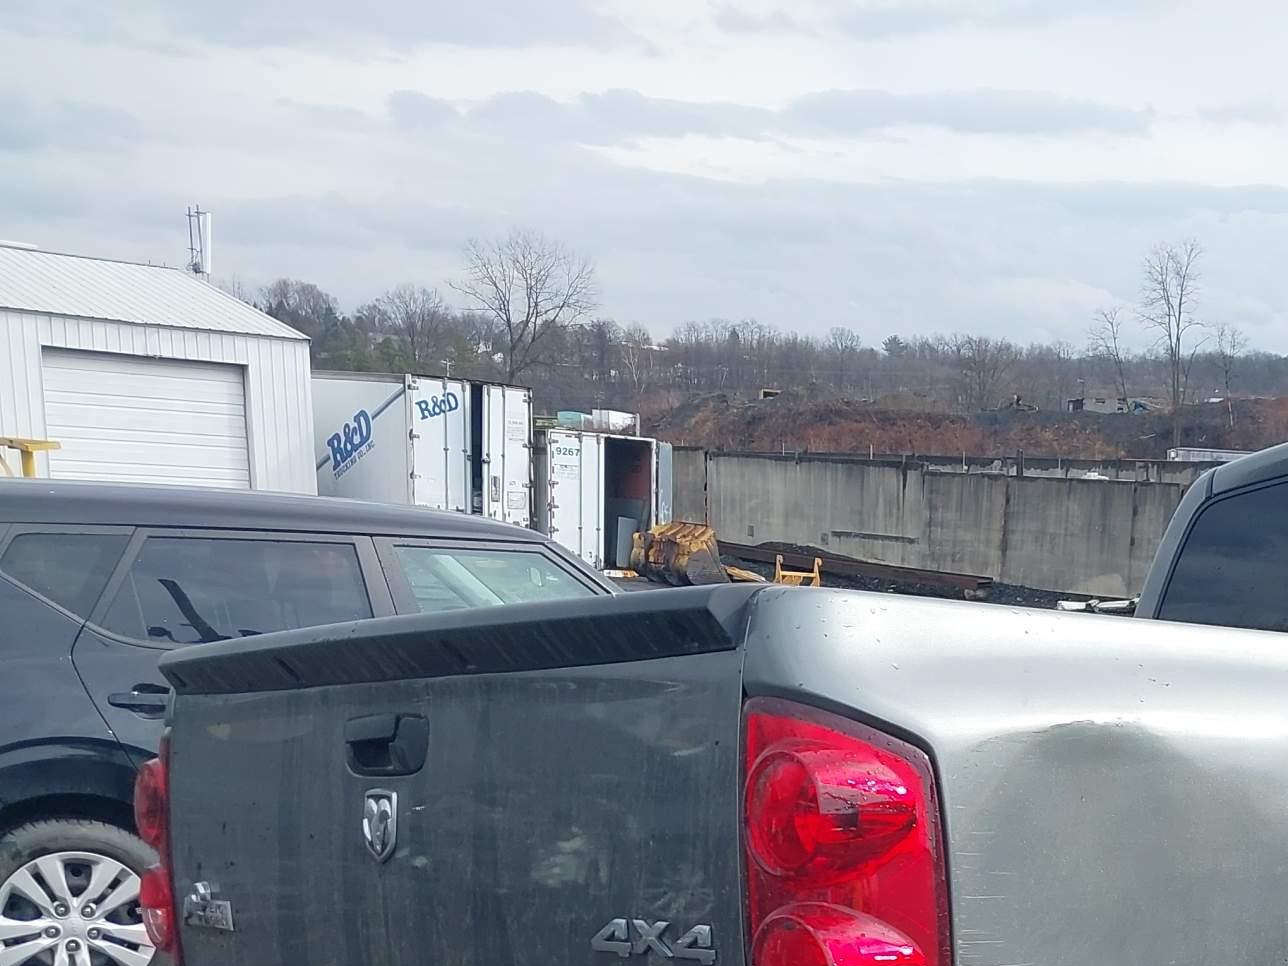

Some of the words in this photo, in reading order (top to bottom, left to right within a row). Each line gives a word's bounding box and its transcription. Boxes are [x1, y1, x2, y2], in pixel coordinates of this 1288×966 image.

[415, 392, 459, 420] R&D
[327, 409, 372, 471] R&D
[555, 446, 580, 457] 9267
